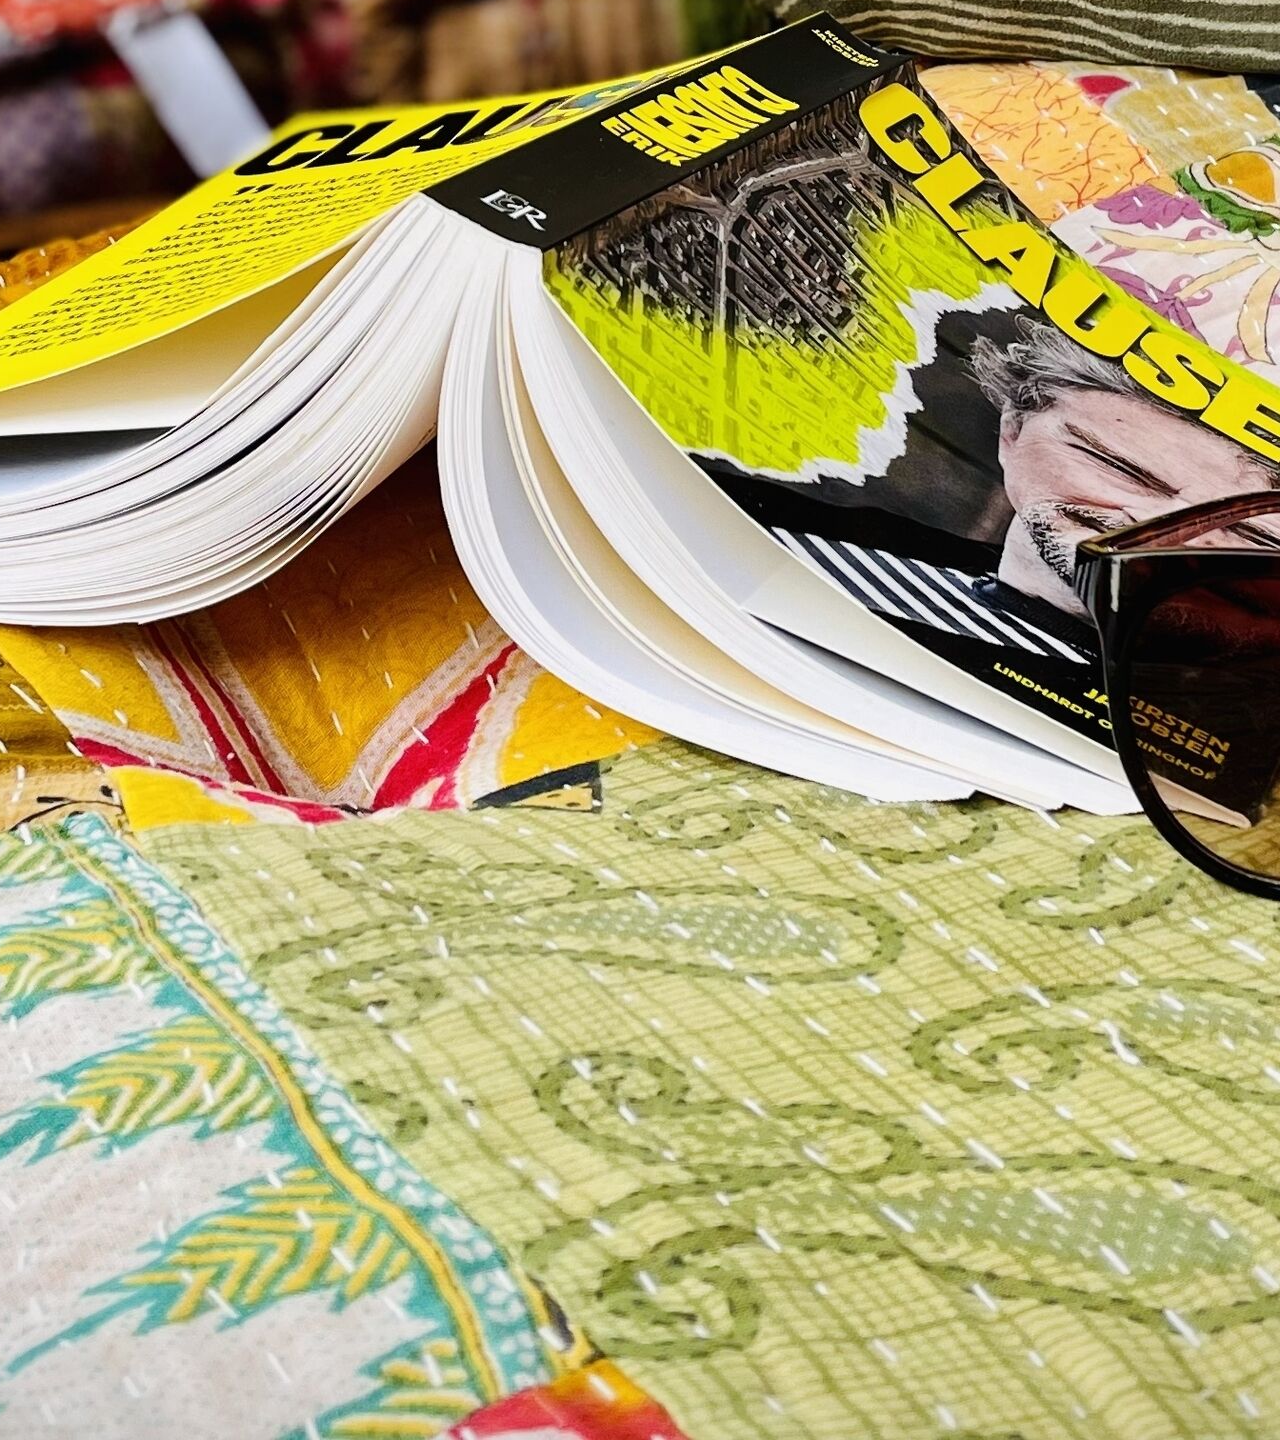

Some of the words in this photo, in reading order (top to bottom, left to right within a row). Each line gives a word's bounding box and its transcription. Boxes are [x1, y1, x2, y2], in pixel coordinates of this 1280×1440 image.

[618, 65, 800, 159] CLAUSEN
[600, 116, 682, 167] ERIK
[993, 662, 1095, 720] LINDHARDT
[1082, 688, 1226, 765] JAOBSEN
[1128, 695, 1231, 753] KIRSTEN
